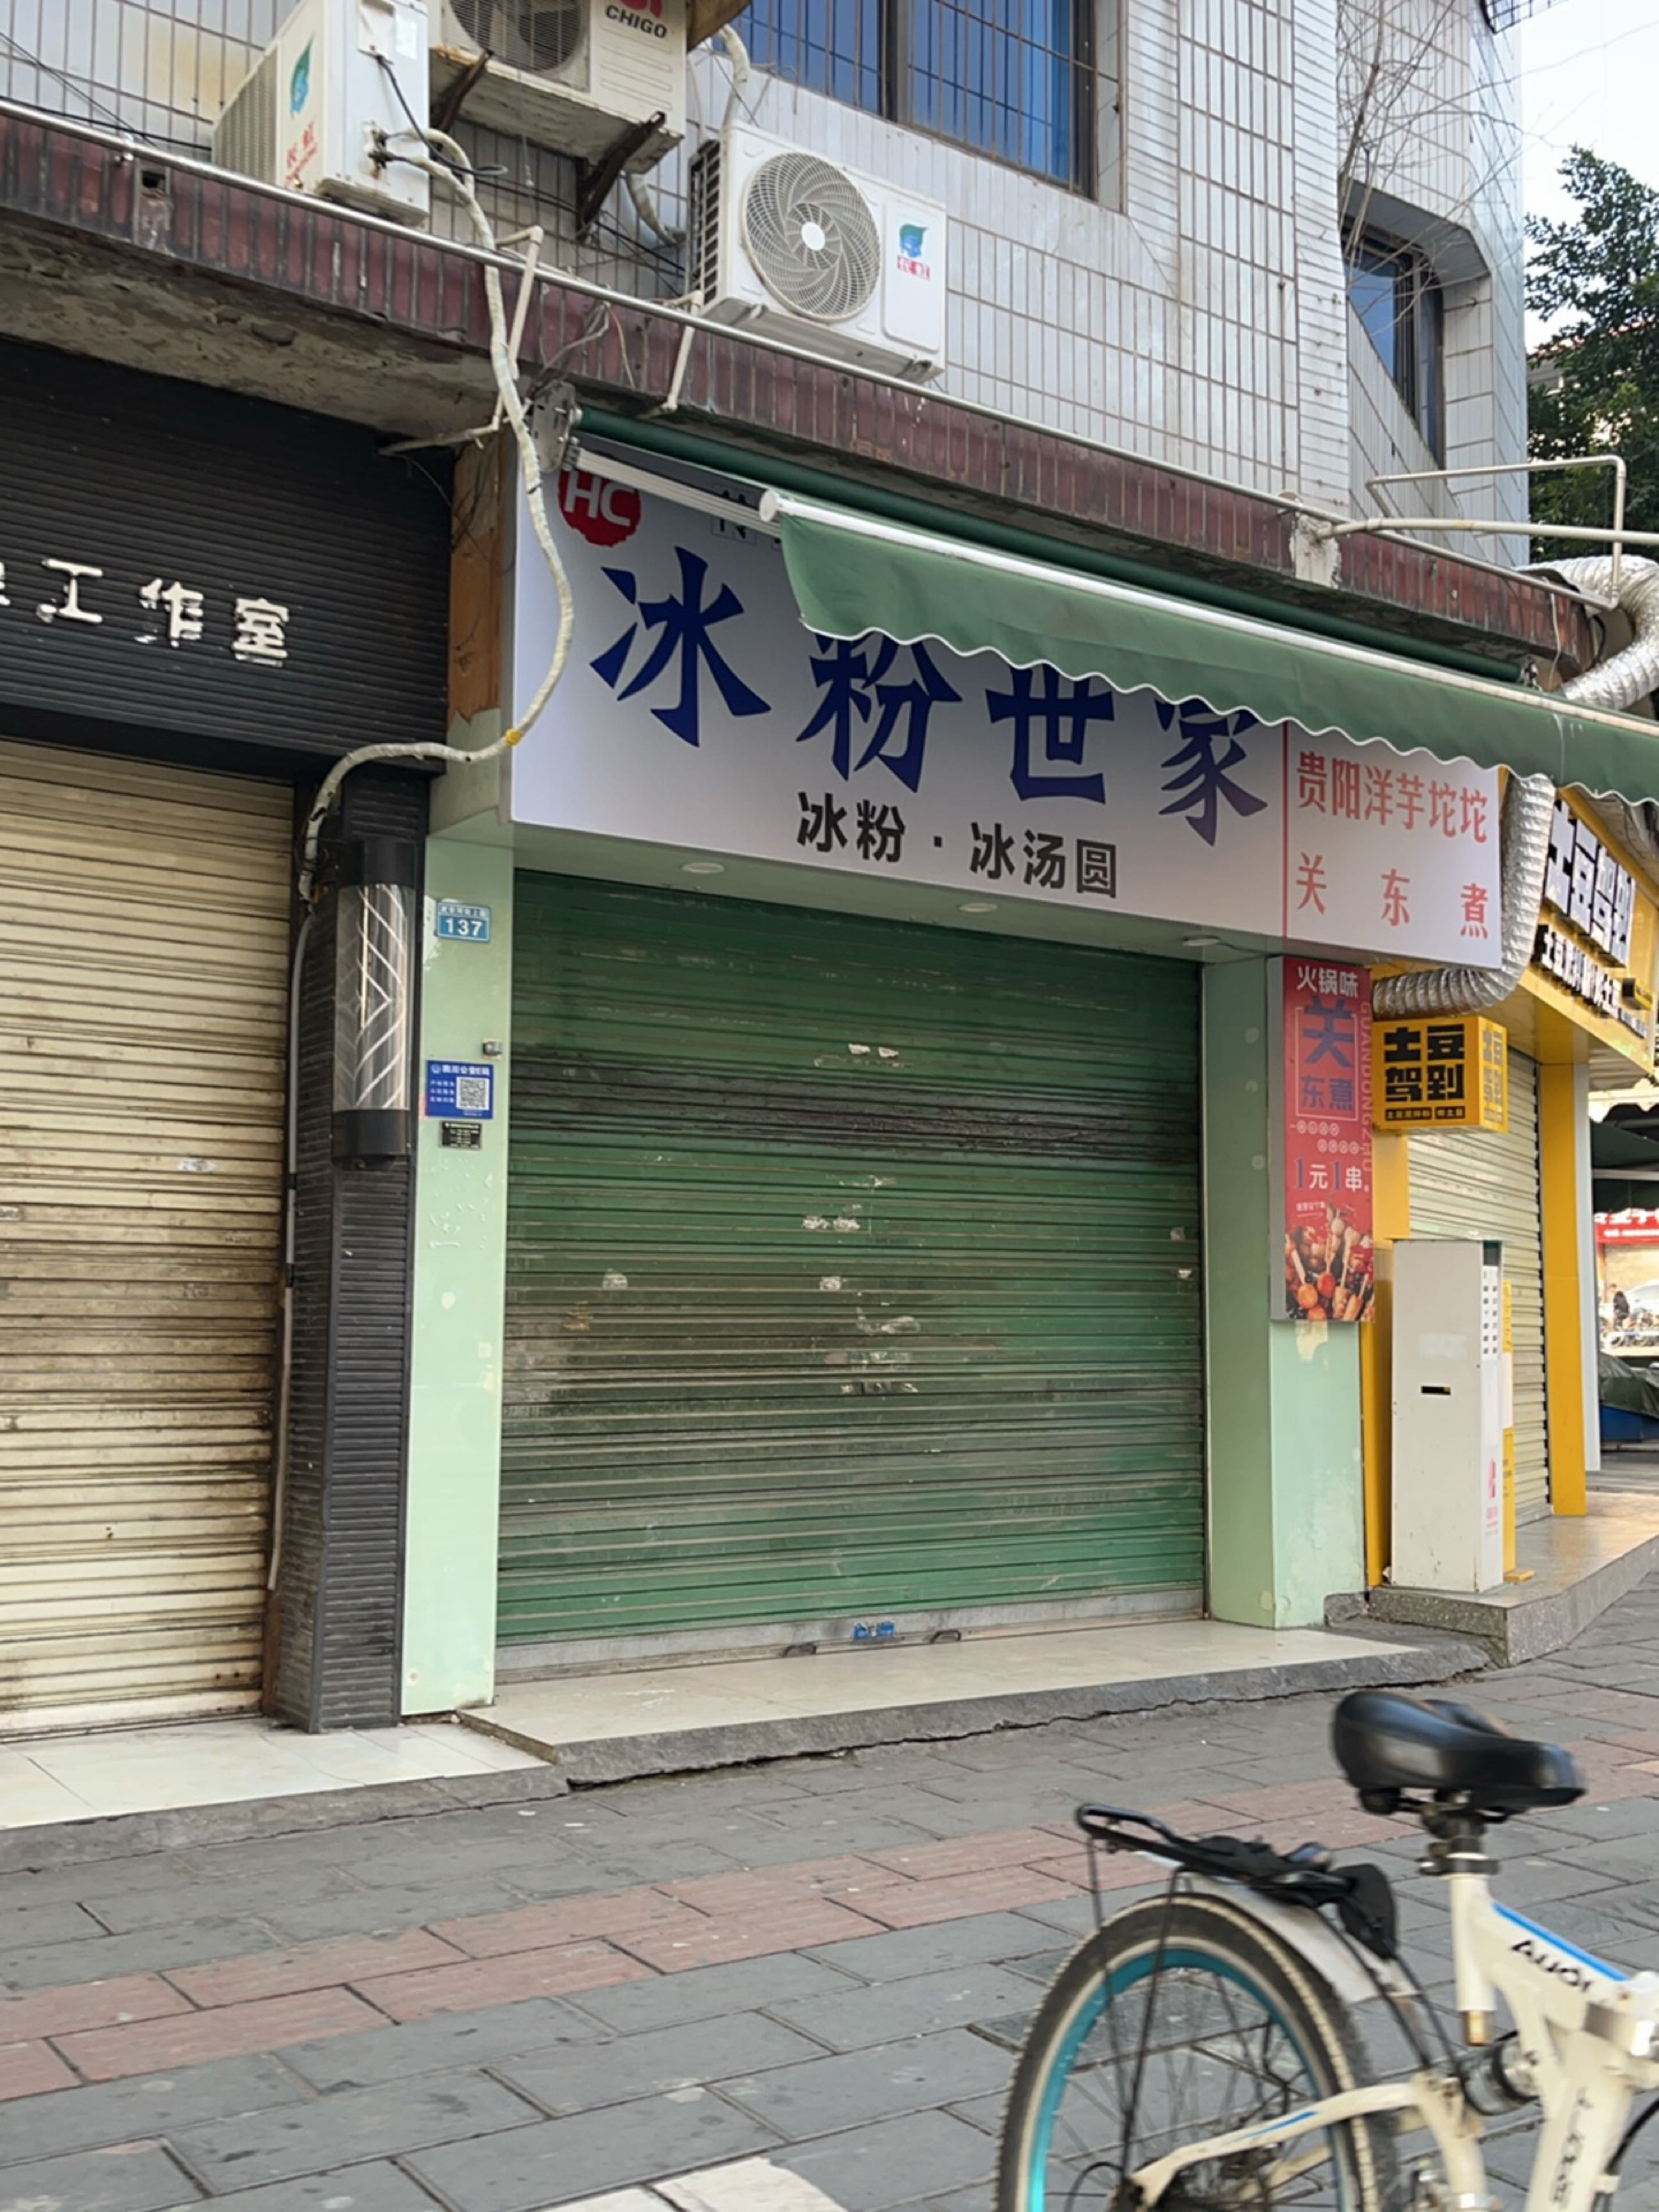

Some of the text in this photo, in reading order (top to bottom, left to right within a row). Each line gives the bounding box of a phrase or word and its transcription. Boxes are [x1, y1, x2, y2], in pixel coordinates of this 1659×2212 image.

[605, 4, 667, 38] CHIGO
[565, 470, 636, 527] HC
[0, 558, 289, 659] 工作室
[589, 546, 1268, 846] 冰粉世家
[1296, 751, 1488, 843] 贵阳洋芋坨坨
[445, 918, 483, 936] 137
[1296, 965, 1359, 998] 火锅味
[1384, 1024, 1464, 1063] 土豆
[1360, 1001, 1373, 1171] GUANDONGZHU
